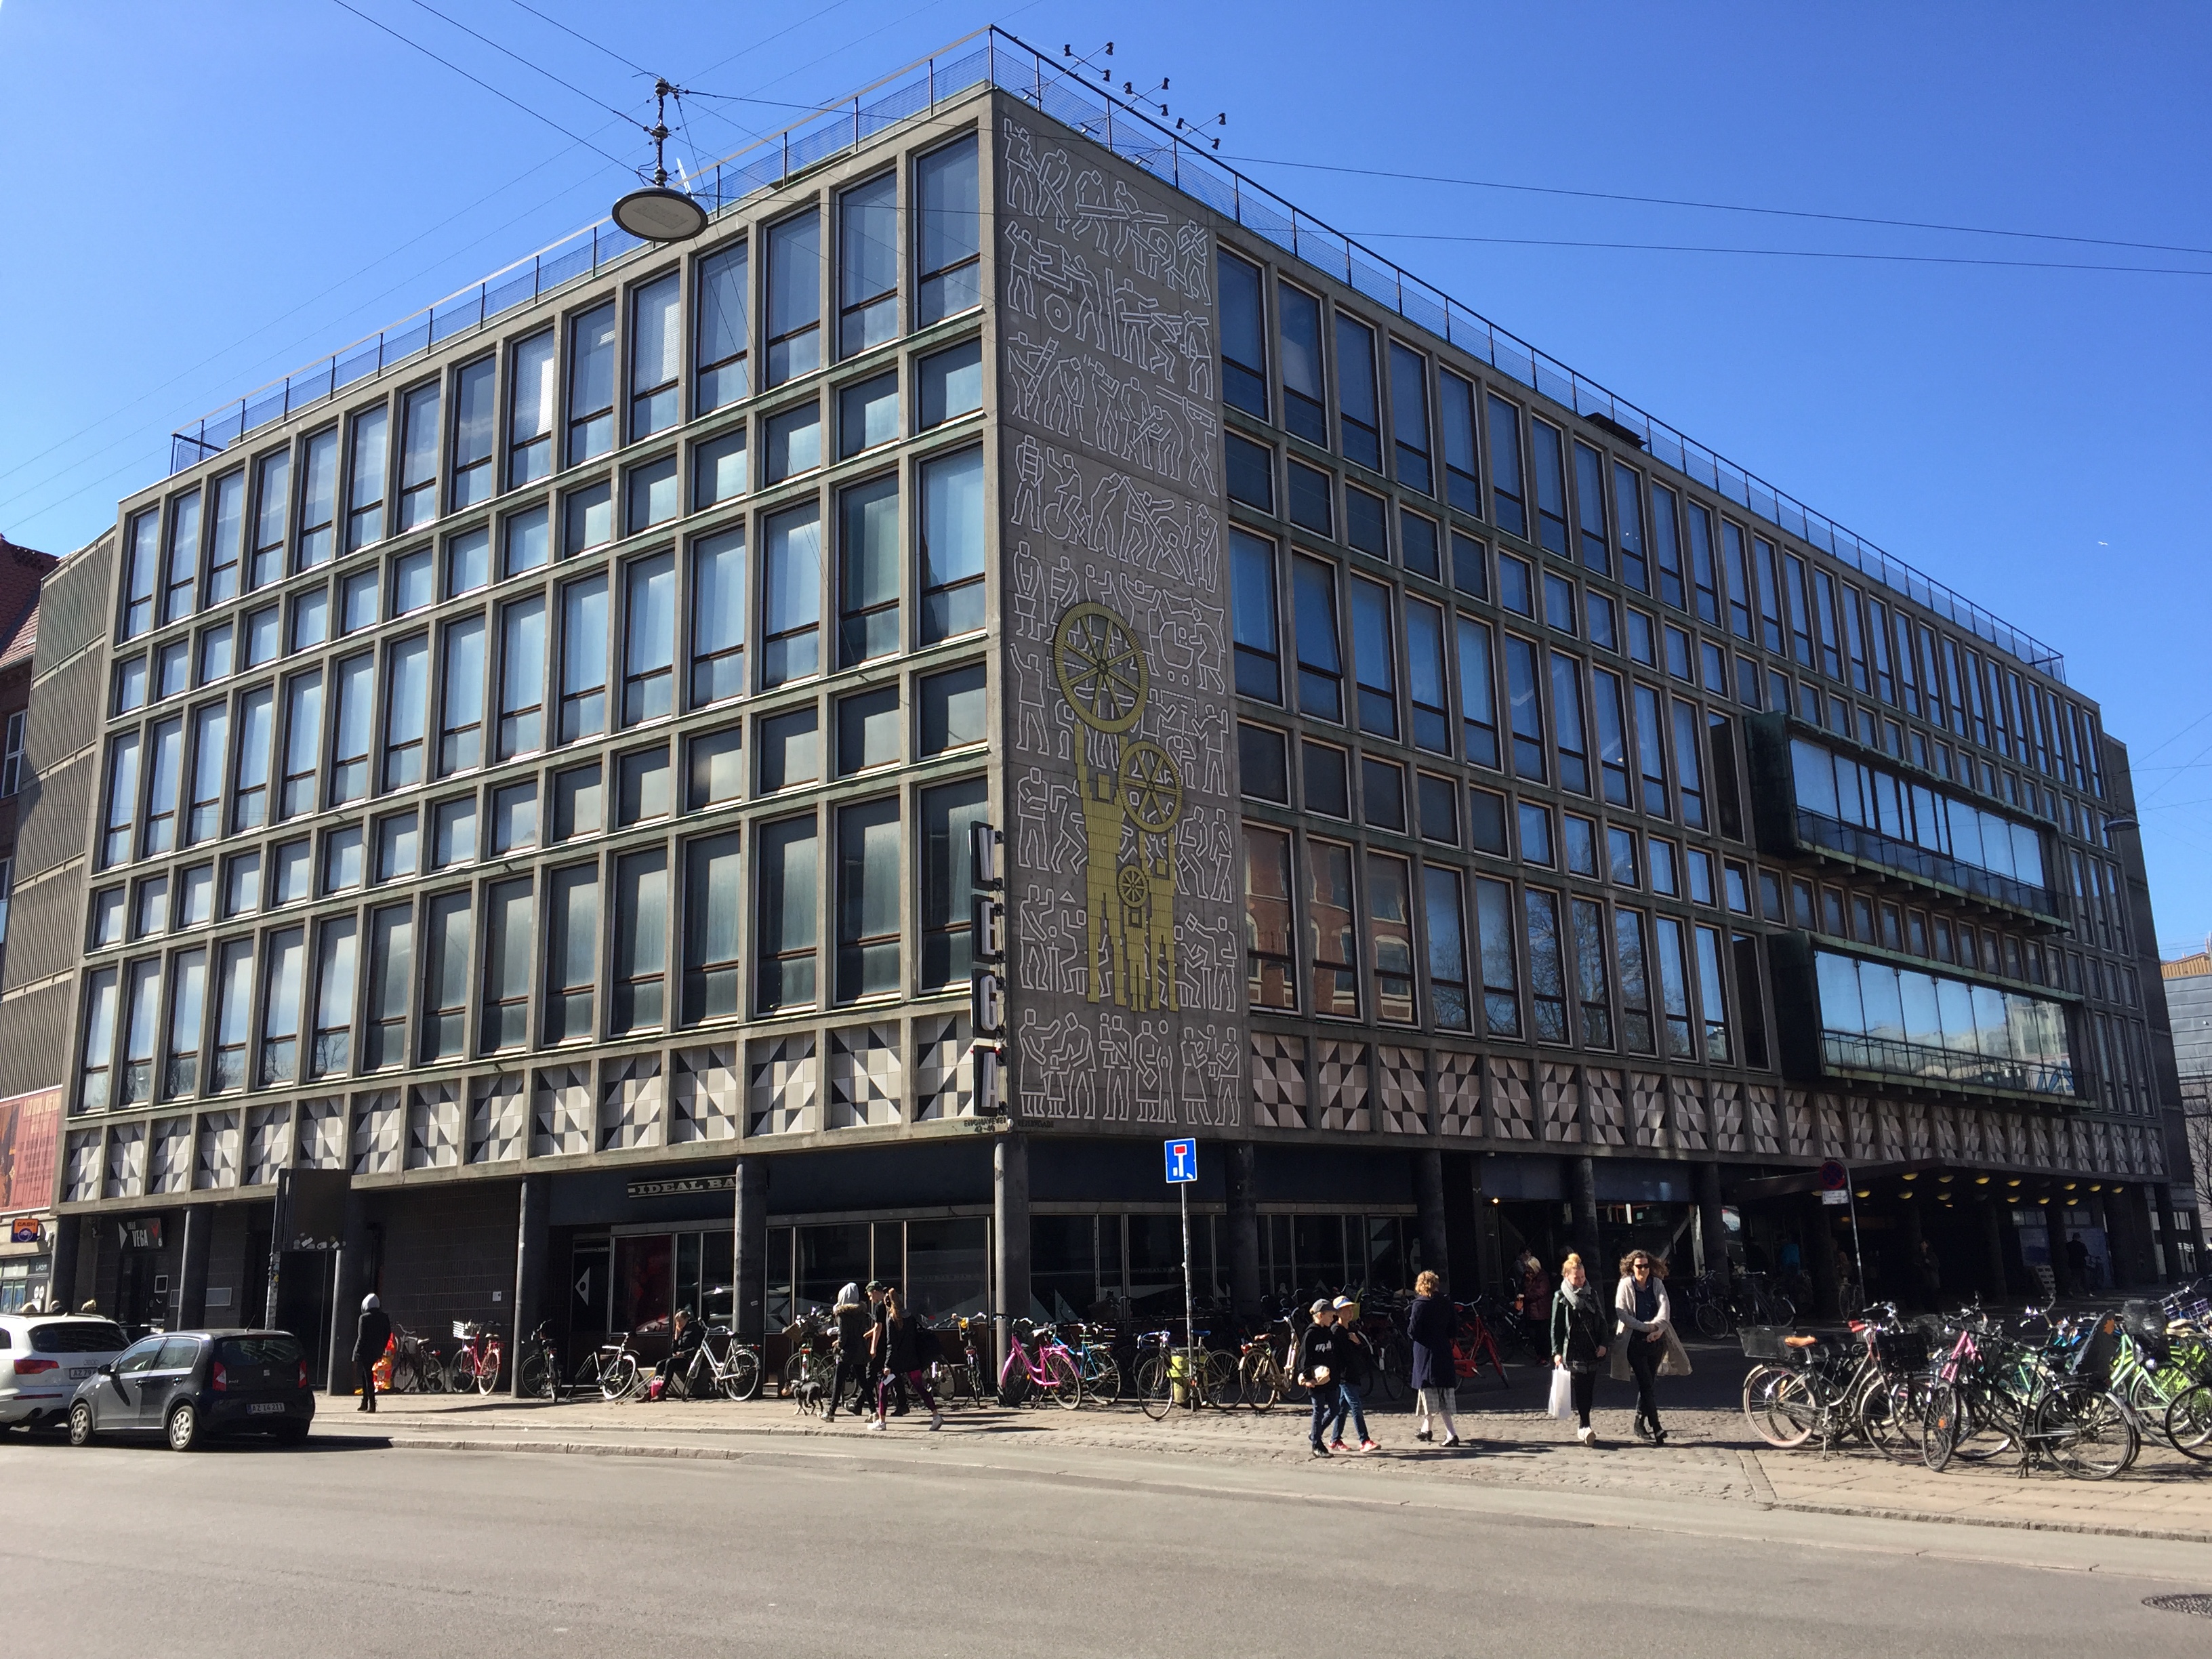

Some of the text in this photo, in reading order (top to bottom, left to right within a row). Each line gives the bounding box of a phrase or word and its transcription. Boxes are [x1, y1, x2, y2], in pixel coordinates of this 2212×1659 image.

[978, 827, 999, 1108] VEGA
[638, 1181, 703, 1194] IDEAL
[131, 1229, 148, 1247] VEGA
